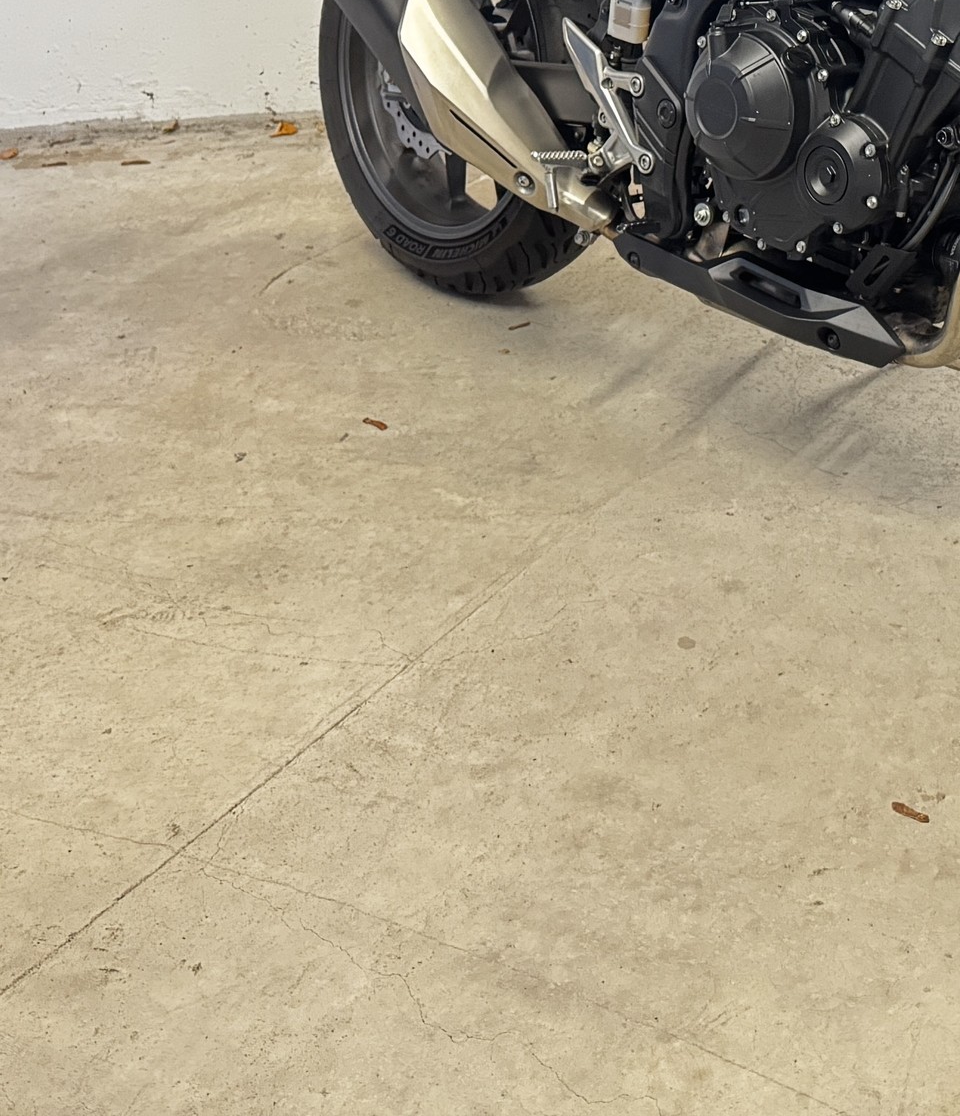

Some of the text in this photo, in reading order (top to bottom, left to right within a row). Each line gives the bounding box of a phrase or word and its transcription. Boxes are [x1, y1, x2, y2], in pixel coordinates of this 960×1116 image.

[386, 227, 490, 258] MICHELIN ROAD 6
